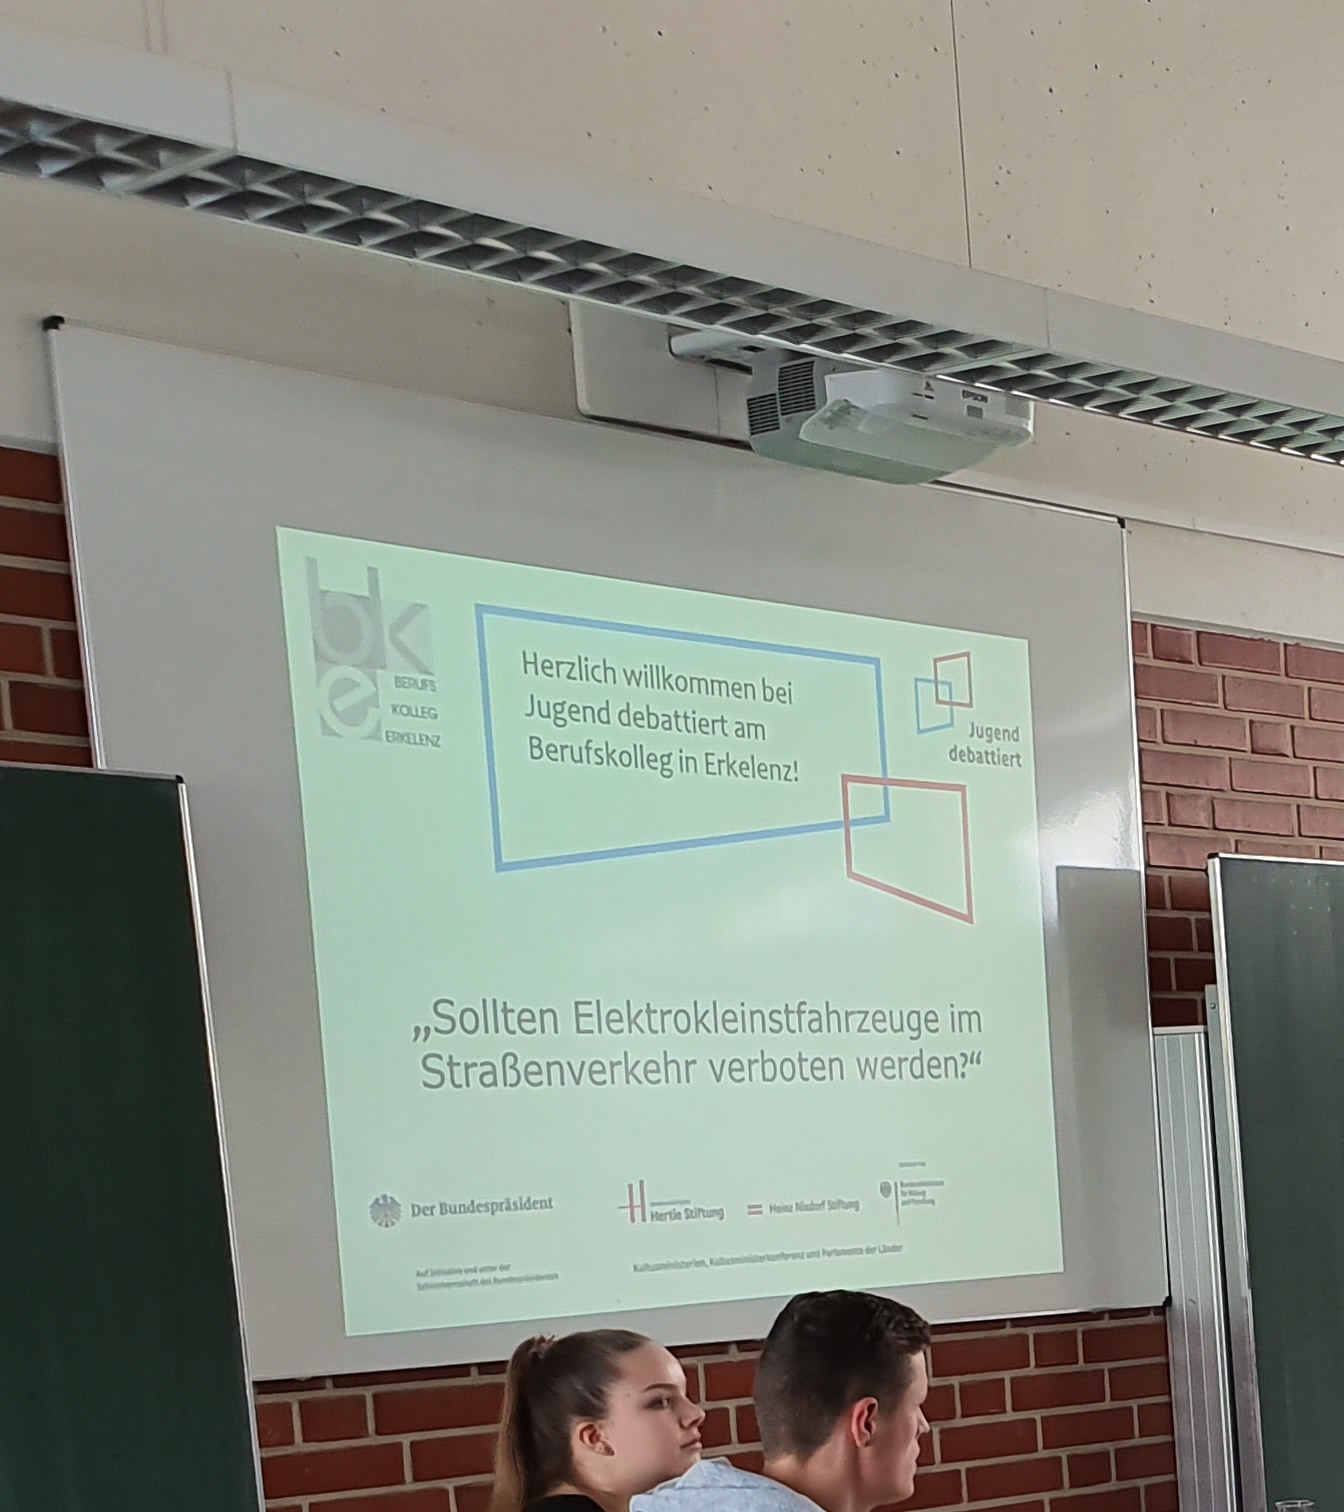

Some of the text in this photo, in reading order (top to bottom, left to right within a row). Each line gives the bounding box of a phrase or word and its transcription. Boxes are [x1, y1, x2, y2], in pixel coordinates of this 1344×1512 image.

[394, 676, 437, 692] BERUFS
[522, 650, 793, 705] Herzlich willkommen bei
[391, 704, 438, 720] KOLLEG
[524, 693, 766, 741] Jugend debattiert am
[385, 730, 441, 747] ERKELENZ
[969, 721, 1020, 744] Jugend
[528, 735, 800, 782] Berufskolleg in Erkelenz!
[949, 744, 1022, 768] debattiert
[412, 998, 983, 1043] „Sollten Elektrokleinstfahrzeuge im
[421, 1048, 983, 1090] Straßenverkehr verboten werden?“
[411, 1196, 554, 1218] Der Bundespräsident
